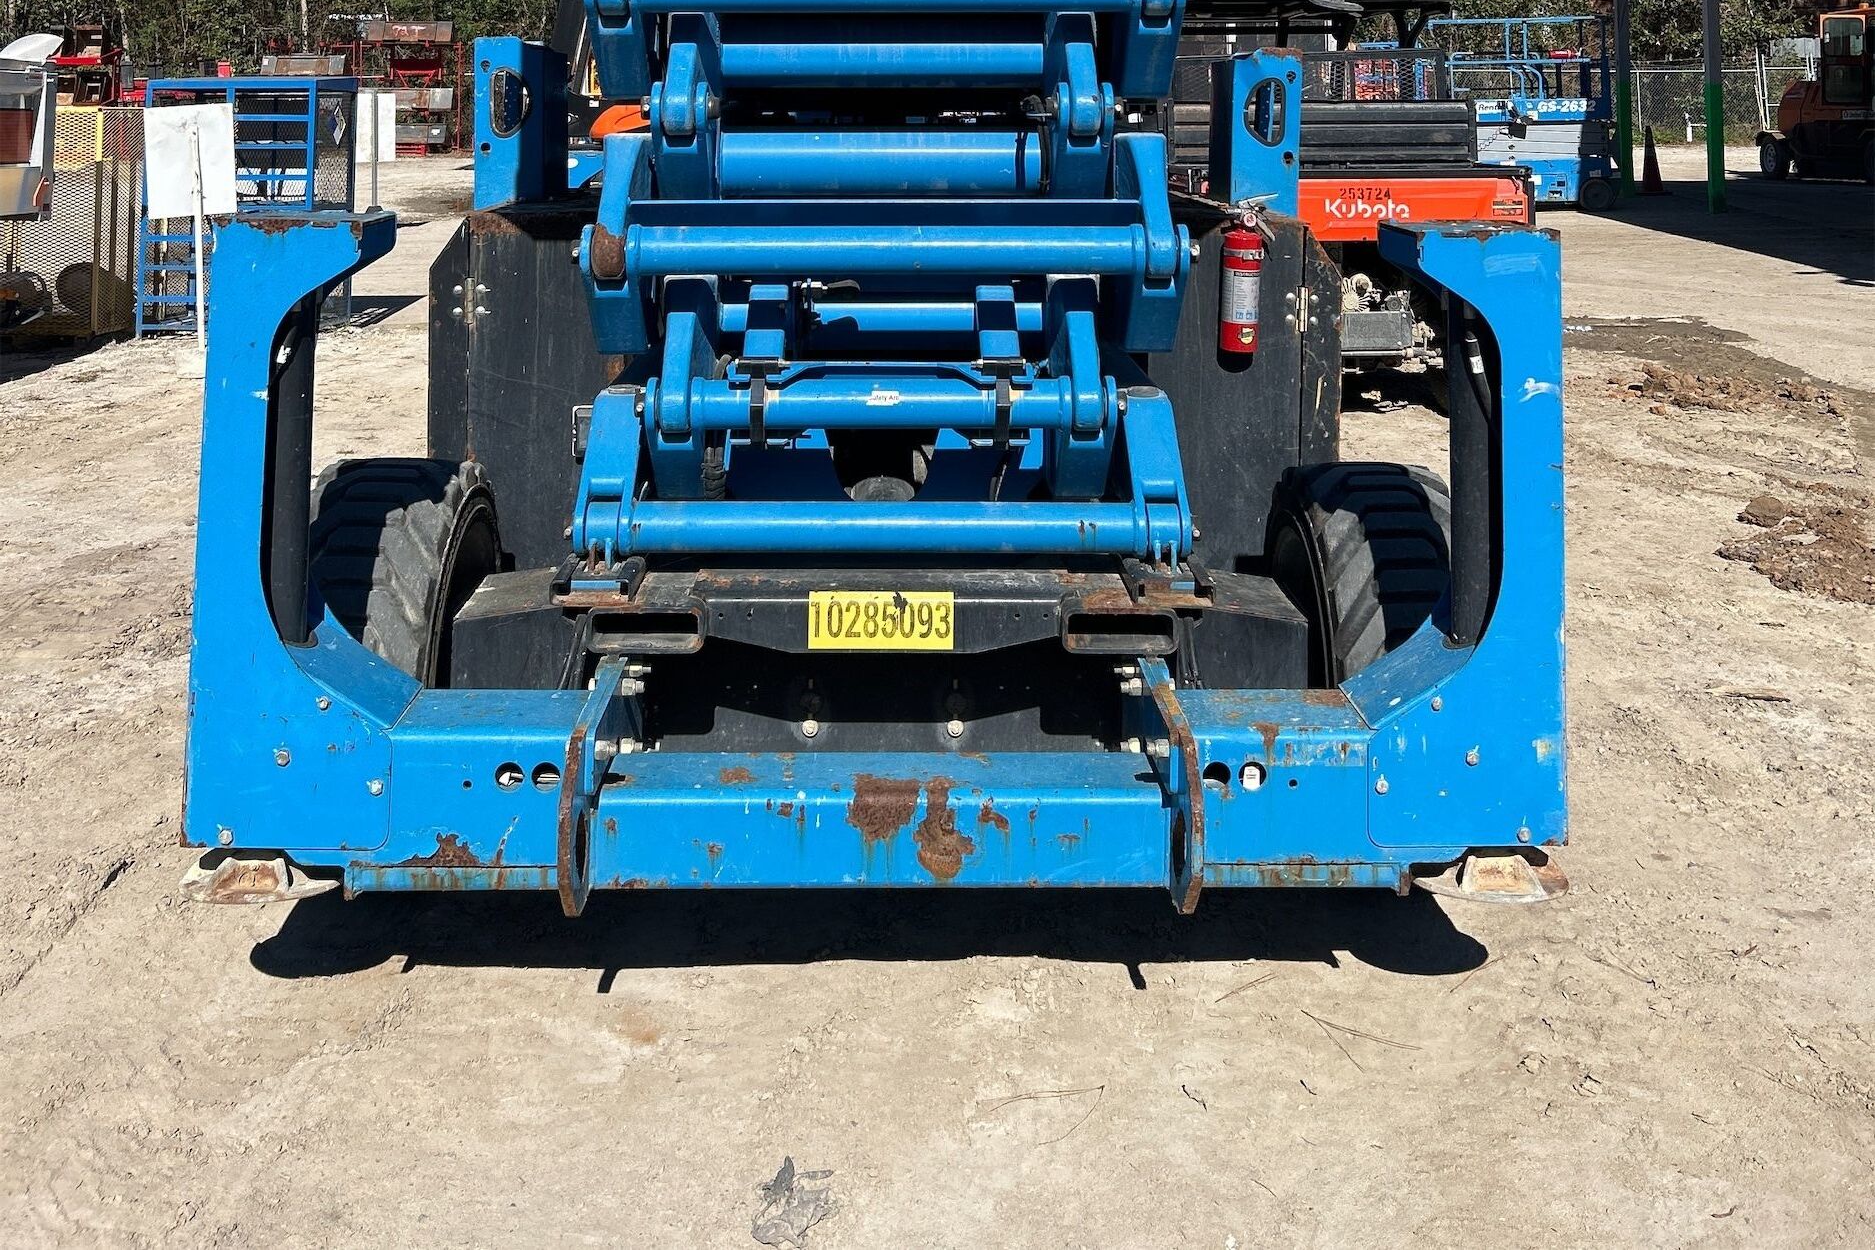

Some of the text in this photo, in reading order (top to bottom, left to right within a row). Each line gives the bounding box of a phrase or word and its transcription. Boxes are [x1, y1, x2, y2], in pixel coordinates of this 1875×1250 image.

[1537, 100, 1597, 113] GS-2632
[1340, 187, 1391, 200] 253724
[1324, 198, 1410, 219] Kubota
[810, 600, 951, 639] 10285093
